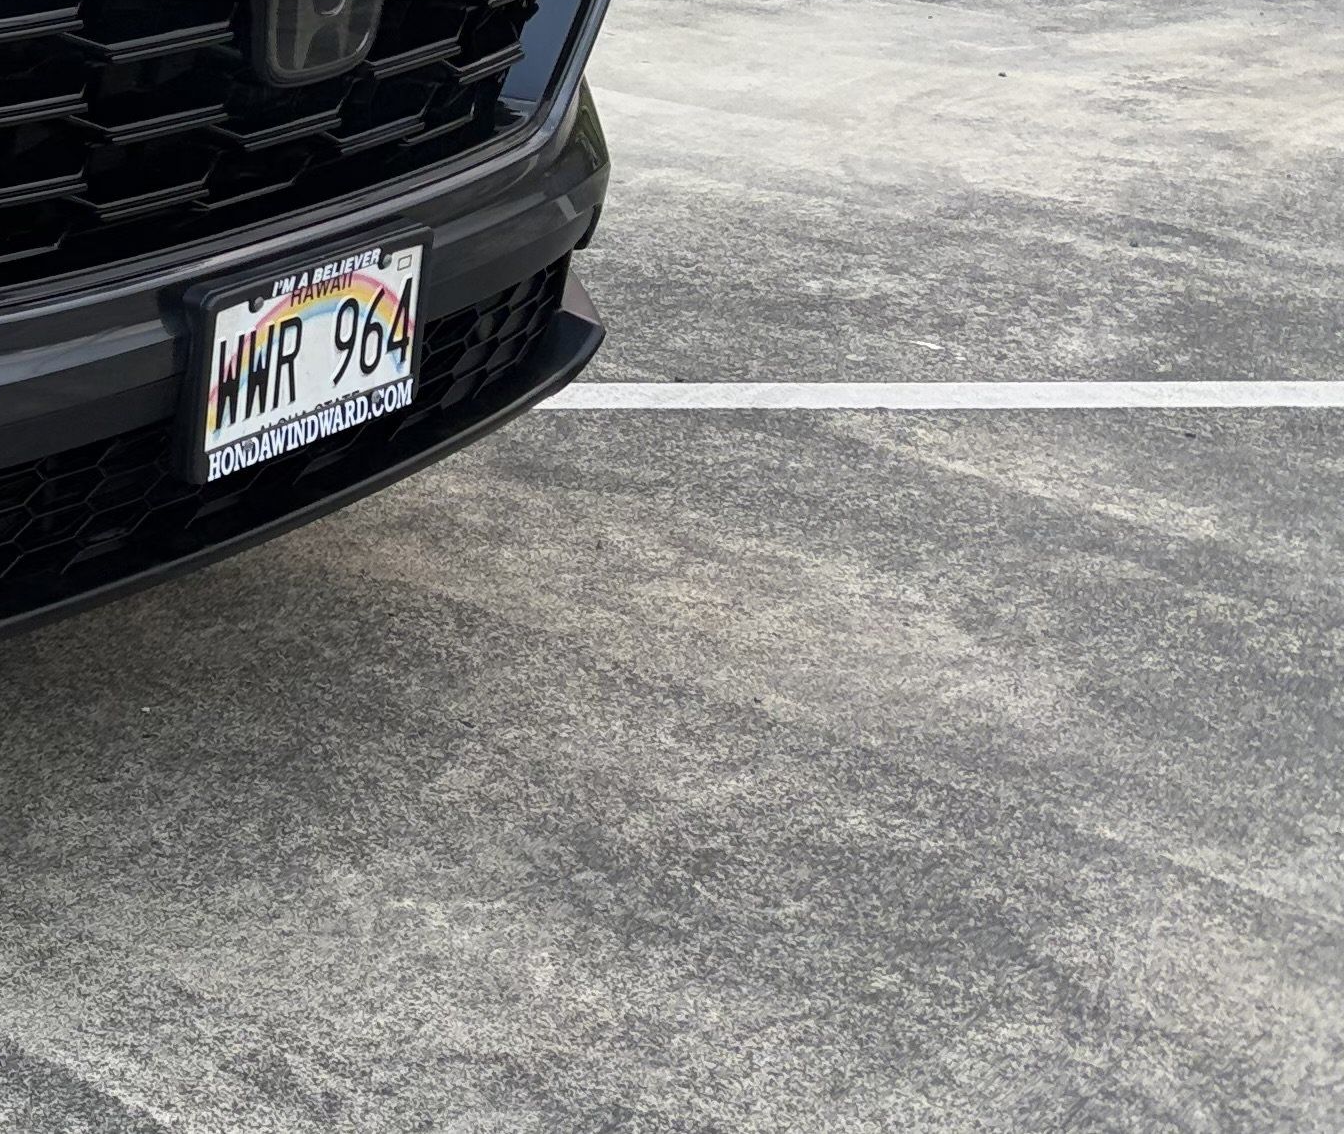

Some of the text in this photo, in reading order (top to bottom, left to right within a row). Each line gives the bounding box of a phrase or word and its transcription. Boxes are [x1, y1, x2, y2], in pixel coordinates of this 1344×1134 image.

[272, 248, 381, 298] I'M A BELIEVER
[290, 272, 353, 307] HAWAII
[215, 273, 413, 431] WWR 964
[207, 379, 414, 482] HONDAWINDWARD.COM
